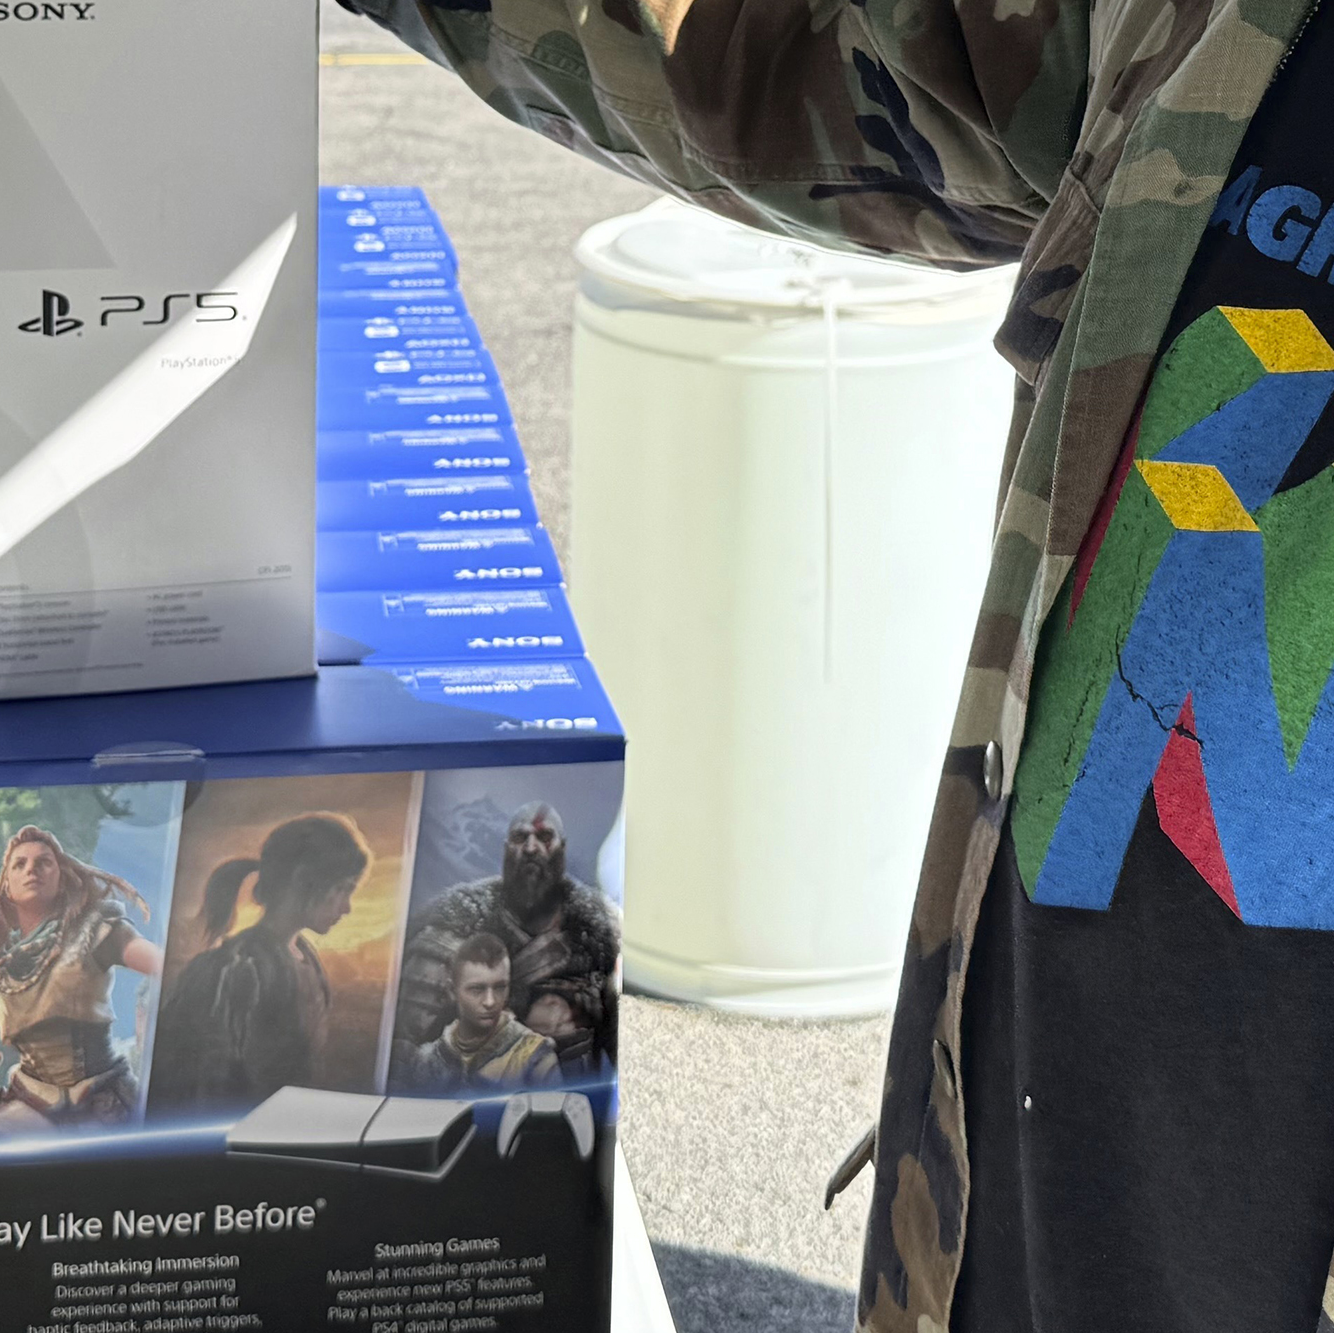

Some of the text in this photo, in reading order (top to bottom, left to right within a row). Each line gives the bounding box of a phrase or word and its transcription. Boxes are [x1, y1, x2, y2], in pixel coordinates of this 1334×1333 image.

[466, 635, 564, 648] SONY
[40, 1213, 102, 1242] Like
[112, 1210, 205, 1238] Never
[374, 1237, 500, 1260] Stunning Games
[52, 1253, 240, 1277] Breathtaking Immersion
[55, 1276, 236, 1298] Discover a deeper gaming
[50, 1294, 240, 1319] experience with support for
[144, 1316, 203, 1333] adaptive
